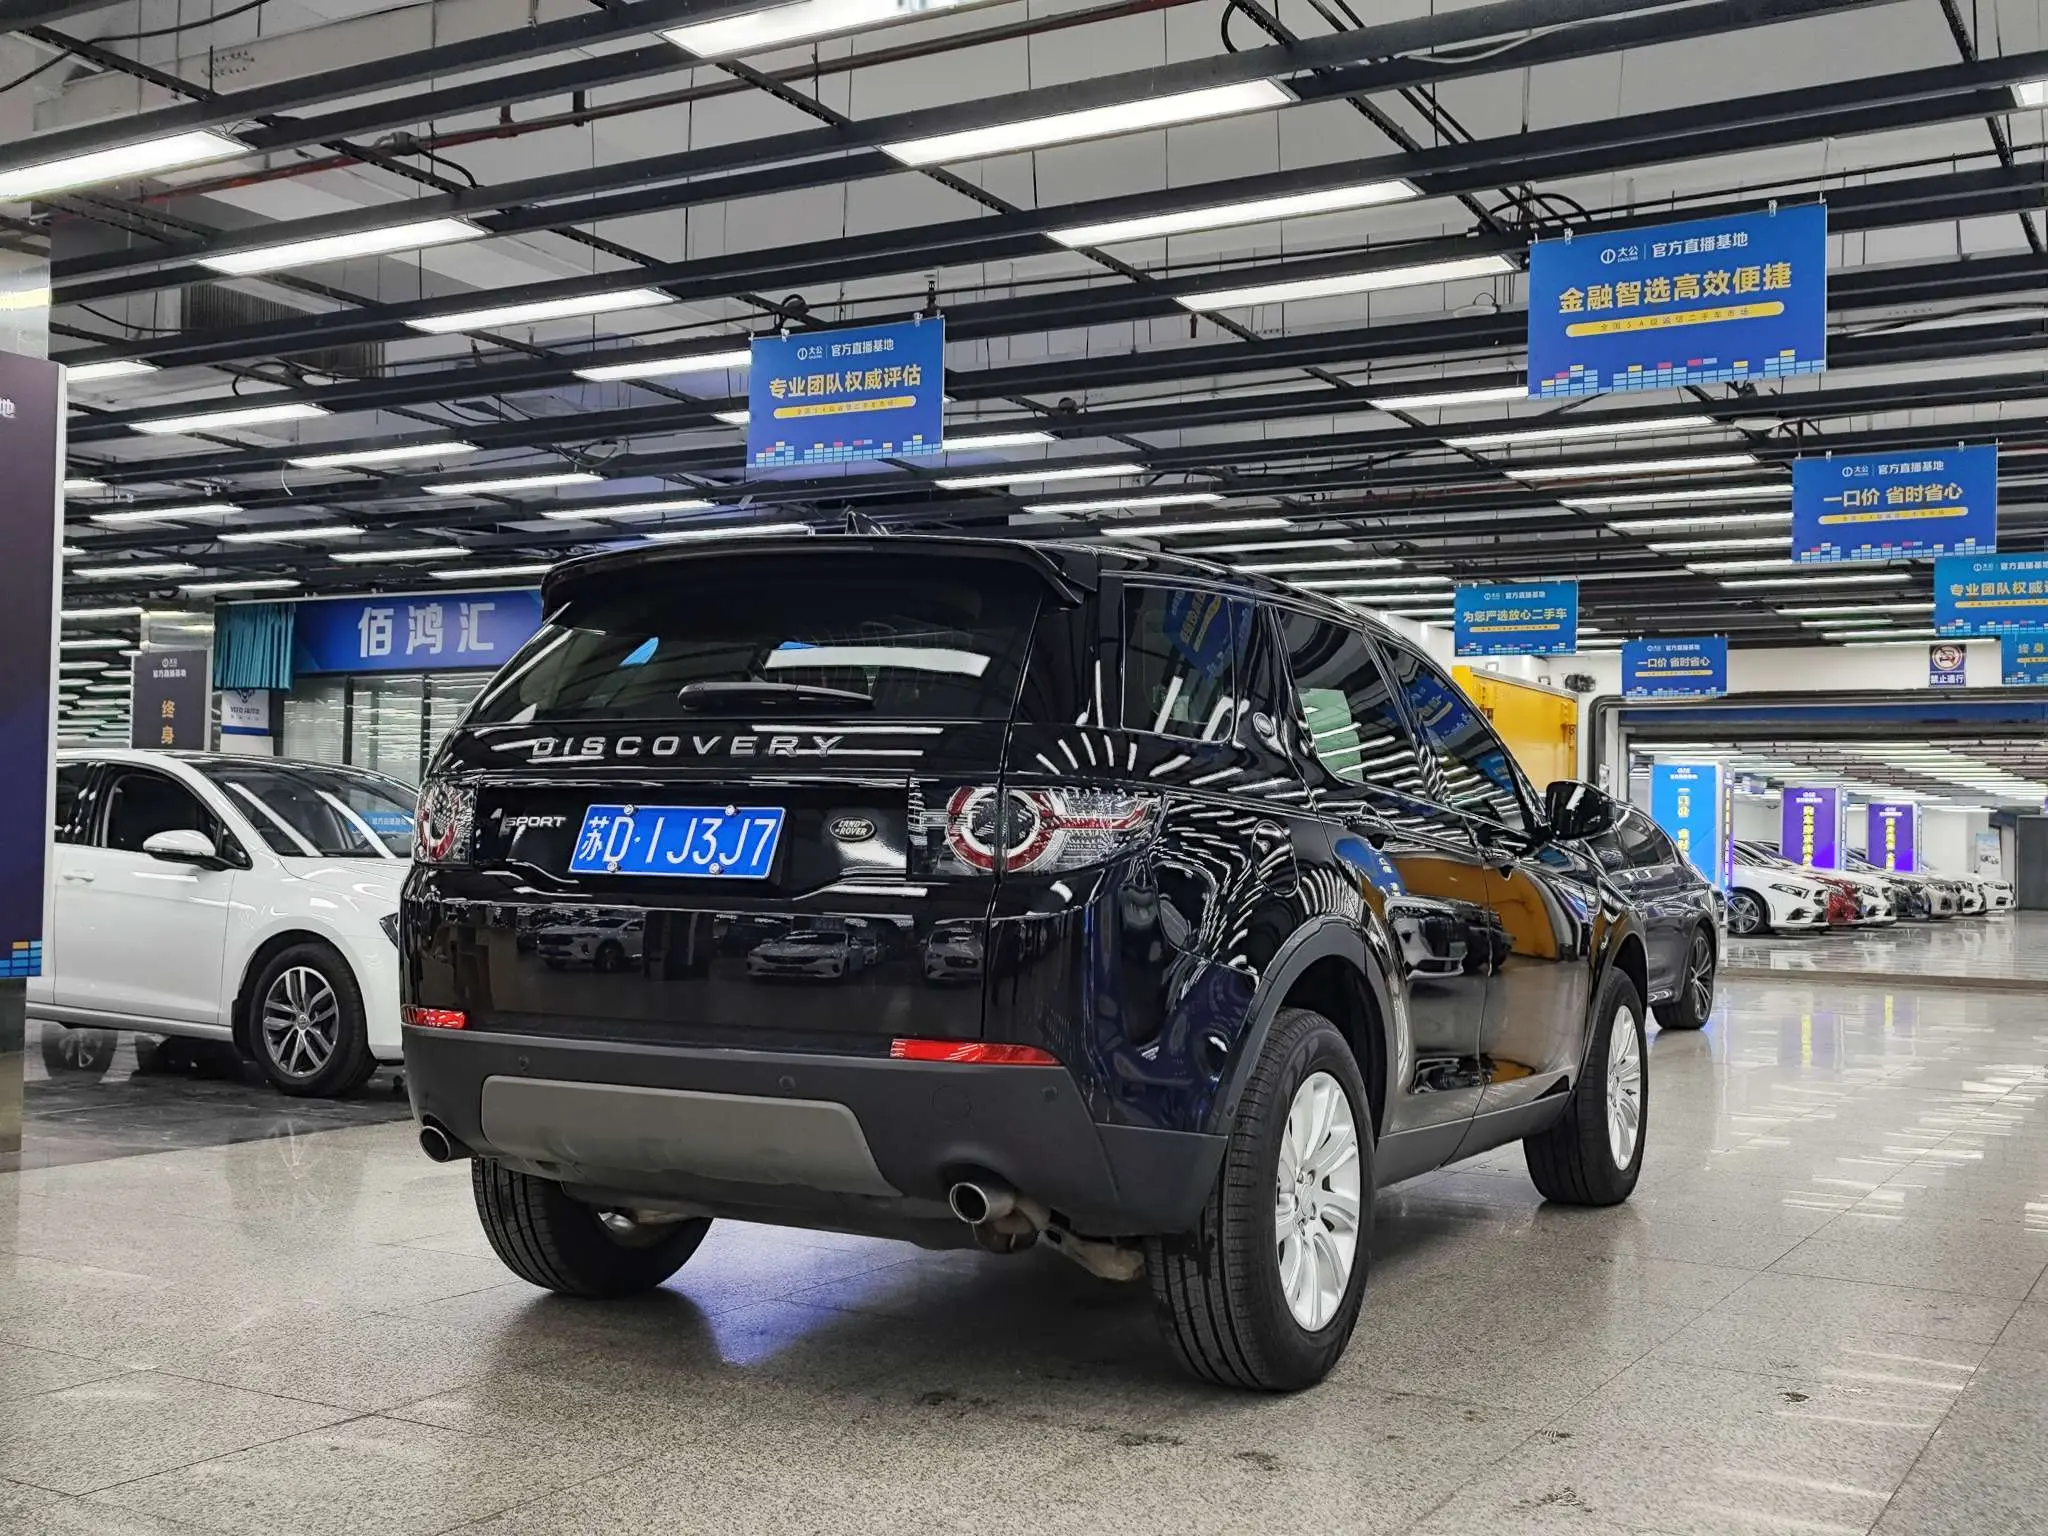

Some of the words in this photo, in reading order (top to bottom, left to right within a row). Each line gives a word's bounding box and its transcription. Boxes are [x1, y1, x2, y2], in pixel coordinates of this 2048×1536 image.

[1617, 245, 1639, 257] 大公
[1652, 232, 1748, 258] 官方直播基地
[1558, 262, 1792, 314] 金融智选高效便捷
[831, 338, 894, 357] 官方直播基地
[769, 364, 922, 399] 专业团队权威评估
[1878, 460, 1945, 475] 官方直播基地
[1823, 488, 1880, 507] 一口价
[1886, 482, 1963, 504] 省时省心
[1463, 608, 1567, 623] 为您严选放心二手车
[358, 602, 496, 658] 佰鸿汇
[531, 736, 843, 757] DISCOVERY
[506, 816, 567, 828] SPORT
[838, 820, 861, 828] LAND
[839, 827, 868, 836] ROVER
